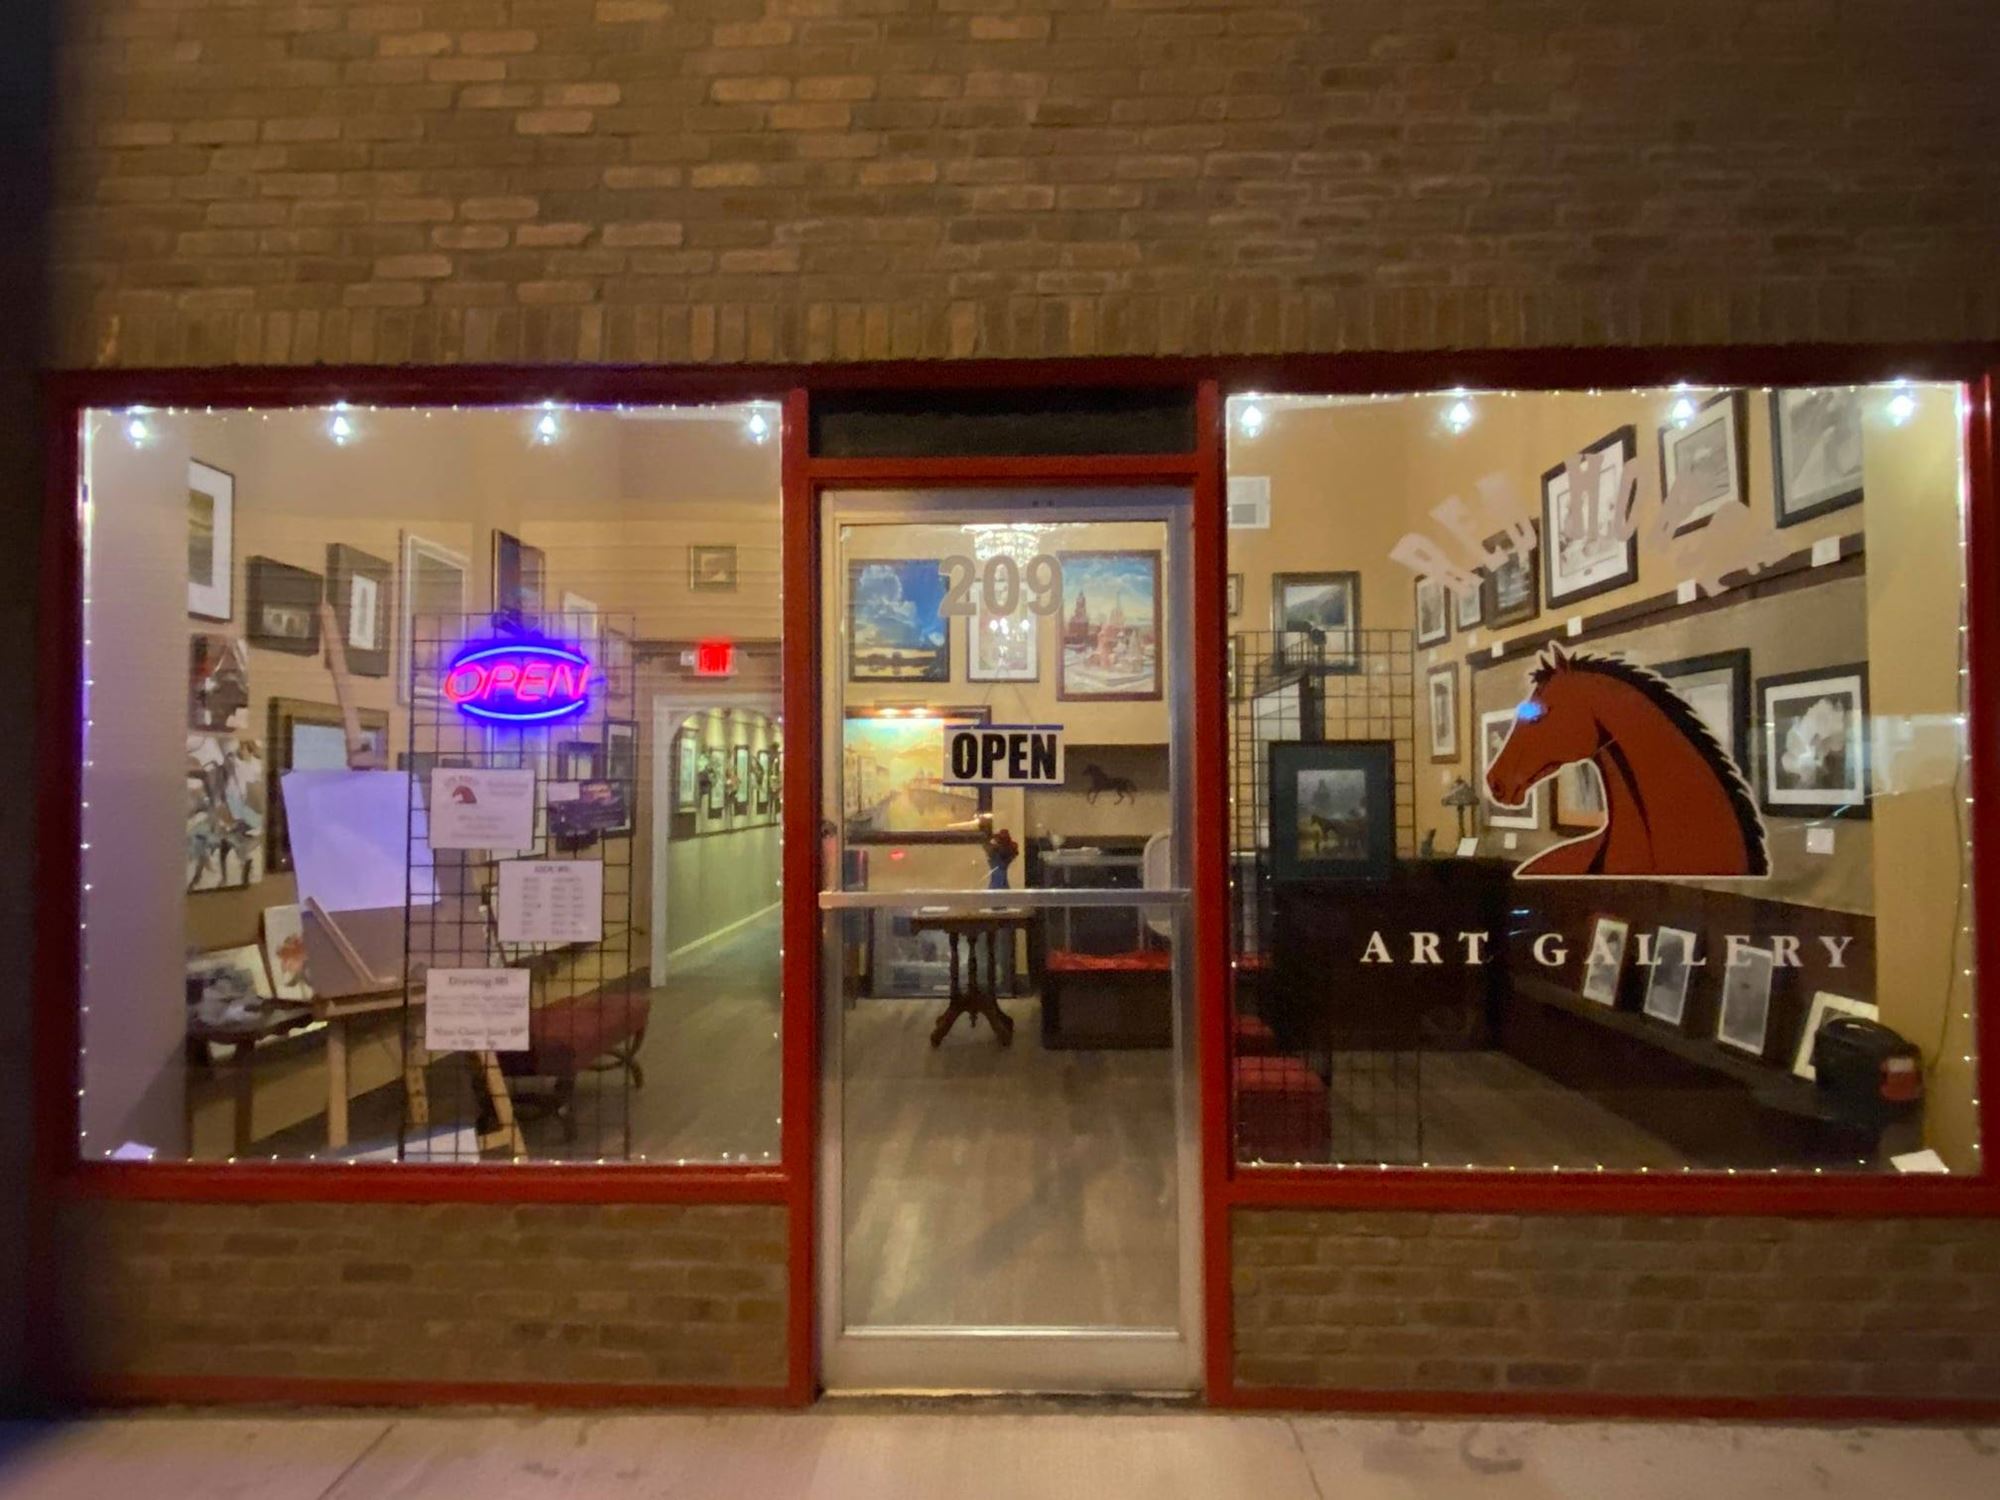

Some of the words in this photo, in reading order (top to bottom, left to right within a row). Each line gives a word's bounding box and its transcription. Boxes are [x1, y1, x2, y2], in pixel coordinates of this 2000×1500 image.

[938, 554, 1064, 618] 209
[445, 662, 591, 703] OPEN
[952, 732, 1058, 781] OPEN
[1360, 931, 1490, 965] ART
[1532, 933, 1854, 969] GALLERY
